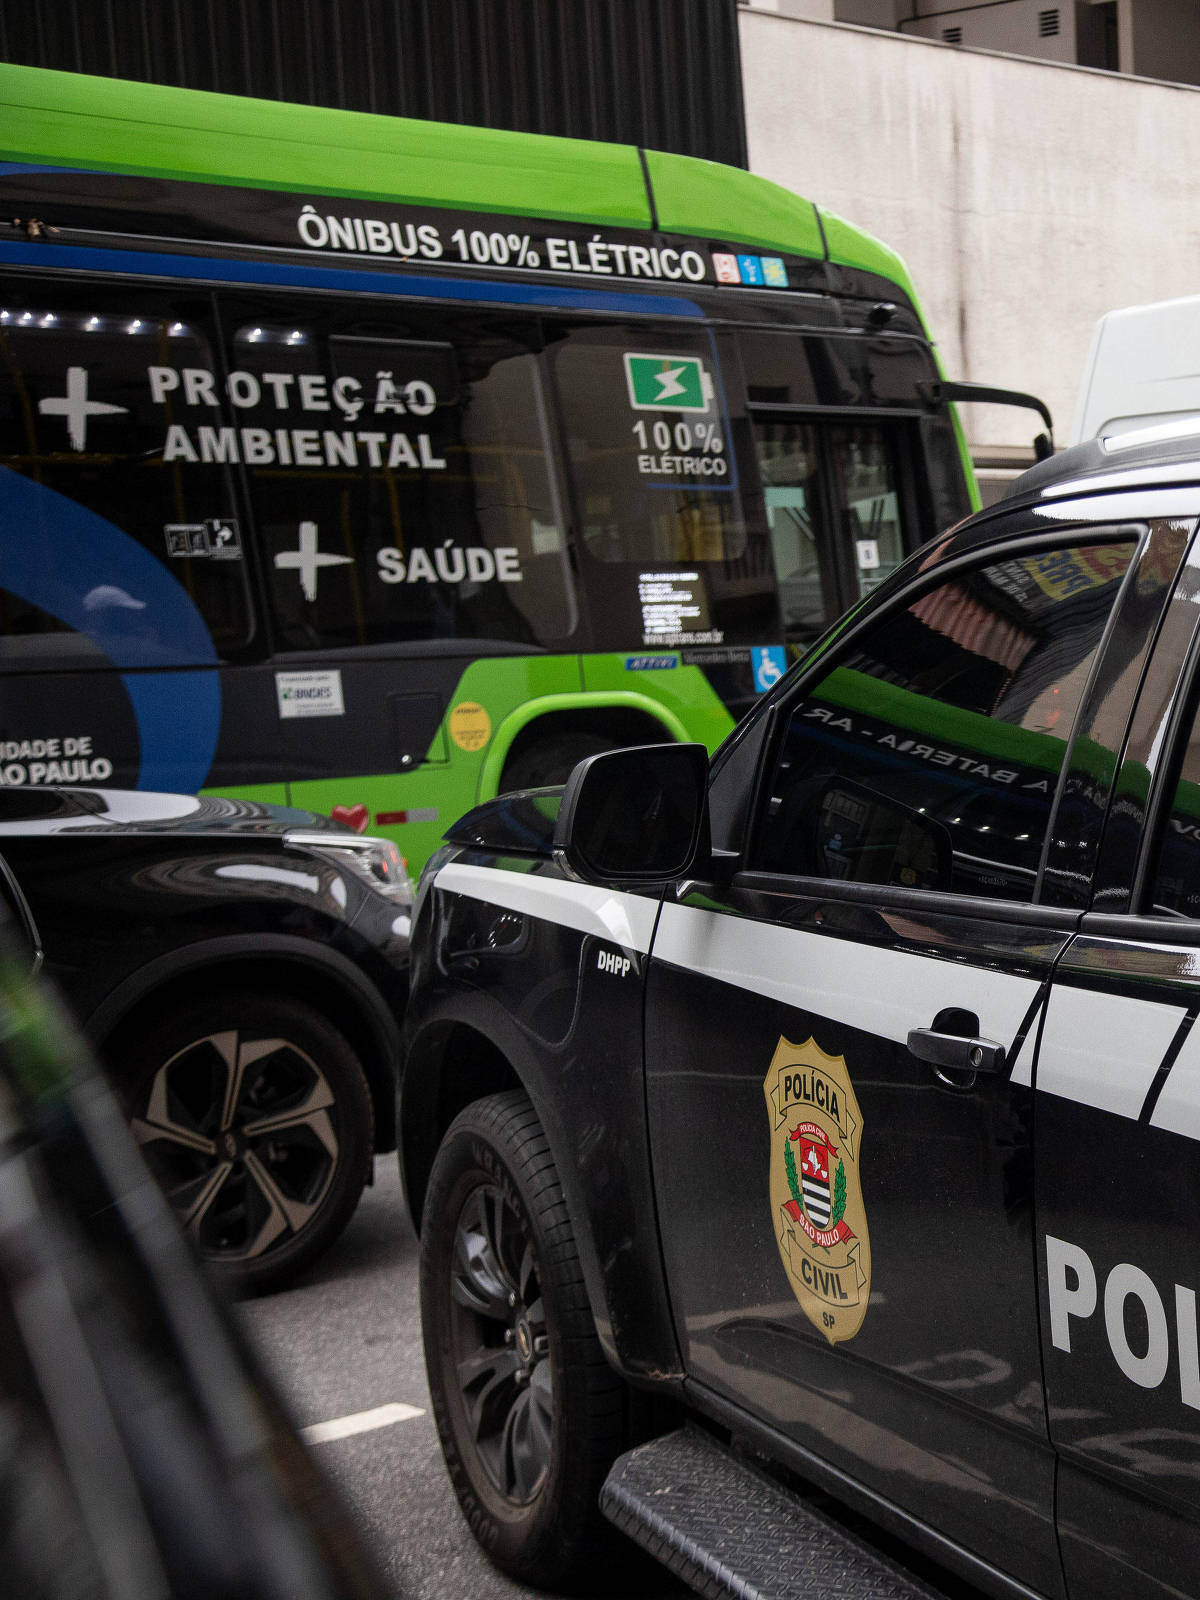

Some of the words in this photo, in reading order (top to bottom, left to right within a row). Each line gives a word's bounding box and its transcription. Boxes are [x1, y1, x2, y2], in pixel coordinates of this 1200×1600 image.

[297, 205, 443, 259] ÔNIBUS
[452, 228, 540, 268] 100%
[546, 235, 706, 281] ELÉTRICO
[148, 366, 437, 421] PROTEÇÃO
[163, 424, 447, 469] AMBIENTAL
[632, 420, 723, 454] 100%
[637, 451, 727, 476] ELÉTRICO
[377, 539, 523, 584] SAÚDE
[0, 739, 61, 760] IDADE
[63, 736, 93, 756] DE
[29, 758, 113, 784] PAULO
[597, 950, 631, 977] DHPP
[784, 1070, 840, 1123] POLÍCIA
[816, 1228, 839, 1246] PAULO
[801, 1258, 848, 1299] CIVIL
[822, 1312, 835, 1329] SP
